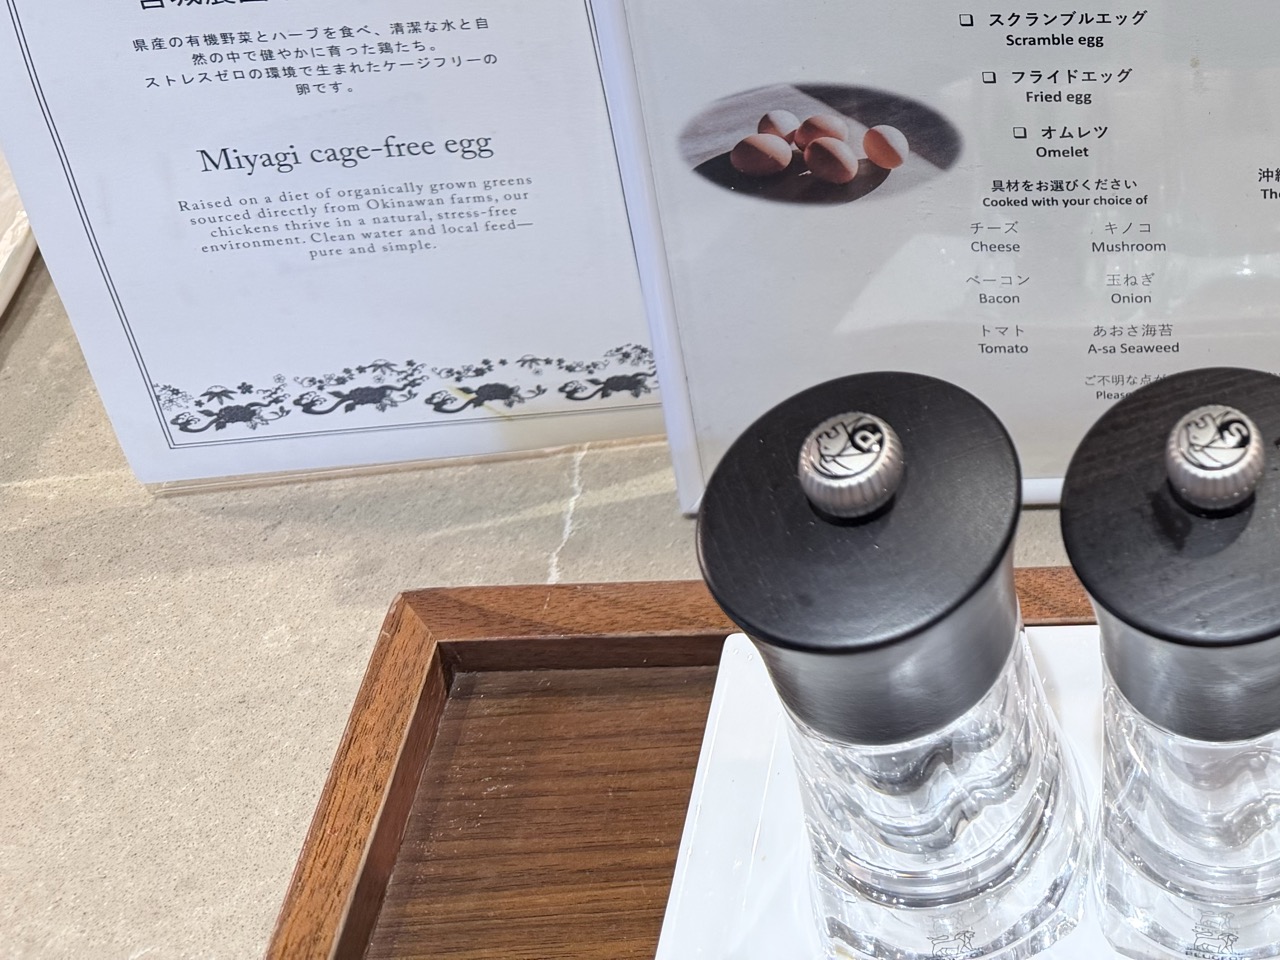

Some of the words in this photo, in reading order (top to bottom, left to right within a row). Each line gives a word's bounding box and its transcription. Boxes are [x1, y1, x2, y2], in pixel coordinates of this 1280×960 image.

[990, 10, 1147, 27] スクランブルエッグ
[1006, 34, 1073, 46] Scramble
[1078, 36, 1104, 48] egg
[192, 40, 438, 65] 然の中で健やかに育った鶏たち。
[146, 54, 498, 88] ストレスゼロの環境で生まれたケージフリーの
[1012, 68, 1132, 84] フライドエッグ
[296, 81, 352, 95] 卵です。
[1026, 91, 1061, 102] Fried
[1067, 94, 1092, 104] egg
[1042, 126, 1108, 139] オムレツ
[196, 148, 301, 175] Miyagi
[310, 135, 435, 168] cage-free
[445, 138, 494, 160] egg
[1036, 146, 1089, 157] Omelet
[991, 179, 1137, 192] 具材をお選びください
[178, 196, 232, 211] Raised
[279, 191, 309, 202] diet
[315, 188, 331, 199] of
[337, 182, 423, 199] organically
[430, 181, 477, 194] grown
[483, 178, 532, 191] greens
[983, 197, 1028, 207] Cooked
[1032, 197, 1058, 206] with
[1062, 198, 1090, 208] your
[1094, 196, 1130, 205] choice
[1136, 195, 1148, 205] of
[190, 209, 251, 225] sourced
[258, 205, 317, 218] directly
[324, 202, 360, 213] from
[366, 198, 444, 210] Okinawan
[450, 193, 498, 204] farms,
[503, 193, 528, 201] our
[211, 224, 279, 237] chickens
[285, 220, 330, 230] thrive
[336, 217, 351, 227] in
[372, 211, 433, 224] natural,
[437, 206, 517, 220] stress-free
[970, 221, 1019, 234] チーズ
[1105, 222, 1150, 235] キノコ
[202, 237, 306, 252] environment.
[310, 232, 355, 243] Clean
[361, 230, 402, 239] water
[409, 224, 436, 236] and
[441, 222, 479, 234] local
[309, 249, 342, 260] pure
[348, 243, 376, 254] and
[382, 240, 436, 253] simple.
[971, 241, 1020, 252] Cheese
[1092, 241, 1166, 252] Mushroom
[966, 275, 1029, 285] ベーコン
[1107, 273, 1155, 286] 玉ねぎ
[979, 293, 1020, 303] Bacon
[1111, 293, 1151, 303] Onion
[983, 325, 1024, 337] トマト
[1093, 324, 1173, 337] あおさ海苔
[978, 344, 1028, 353] Tomato
[1088, 344, 1116, 354] A-sa
[1121, 342, 1179, 353] Seaweed
[1223, 422, 1249, 447] S
